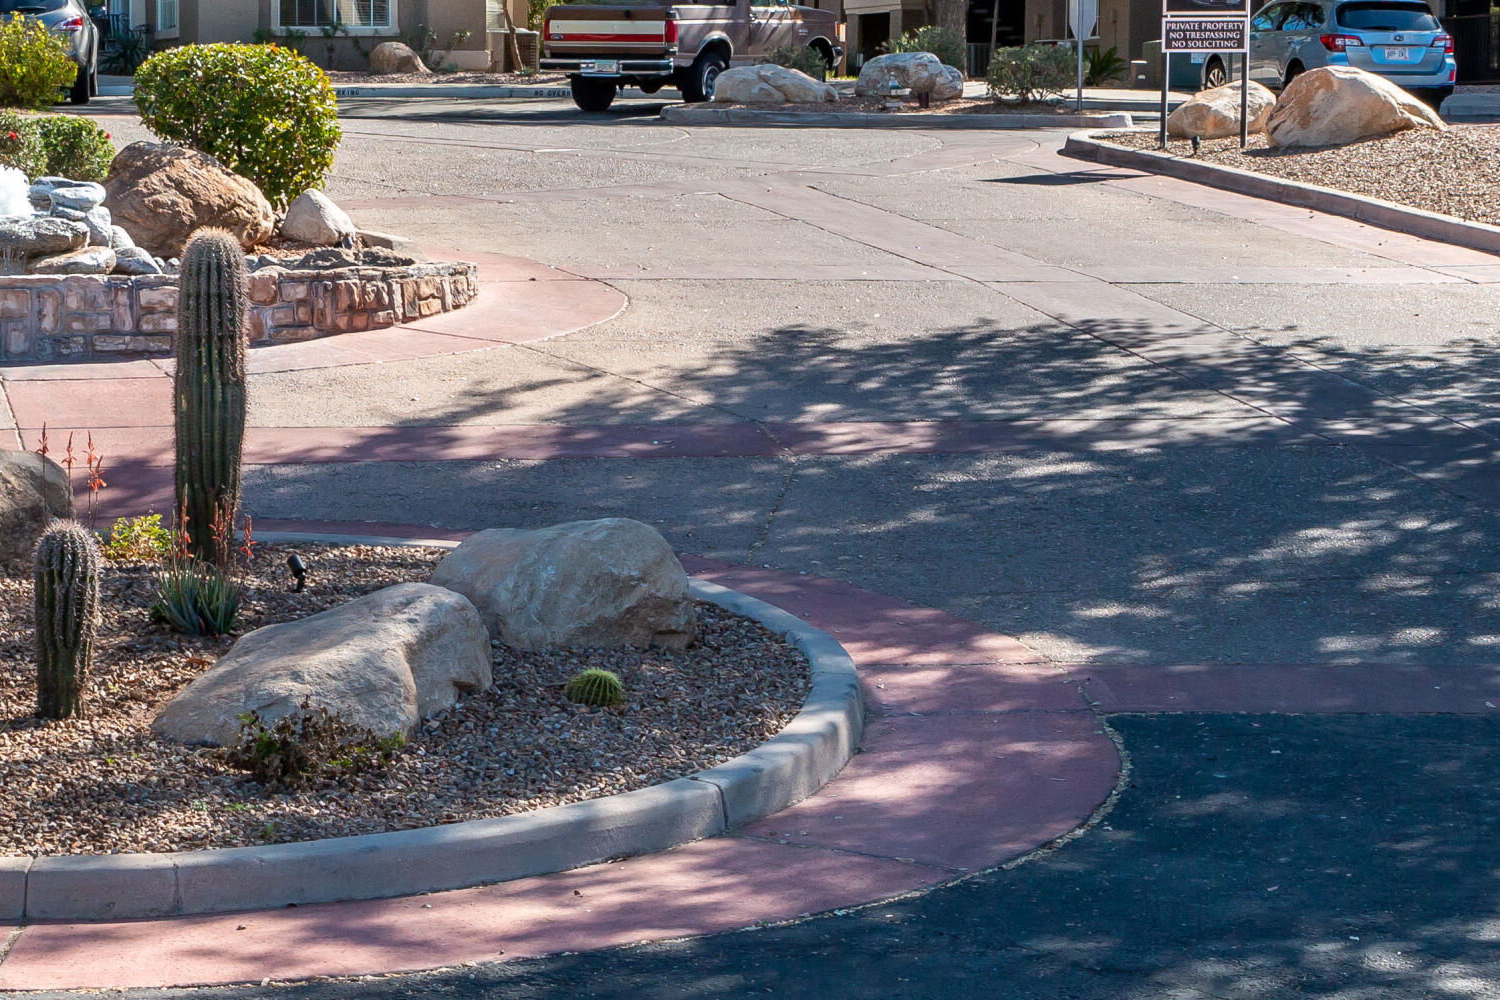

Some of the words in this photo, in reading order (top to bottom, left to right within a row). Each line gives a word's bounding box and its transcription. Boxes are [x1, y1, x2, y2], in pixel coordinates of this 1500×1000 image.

[1166, 22, 1200, 30] PRIVATE
[1201, 22, 1244, 30] PROPERTY
[1169, 31, 1184, 39] NO
[1185, 31, 1240, 39] TRESPASSING
[1171, 40, 1186, 48] NO
[1187, 40, 1238, 48] SOLICITING
